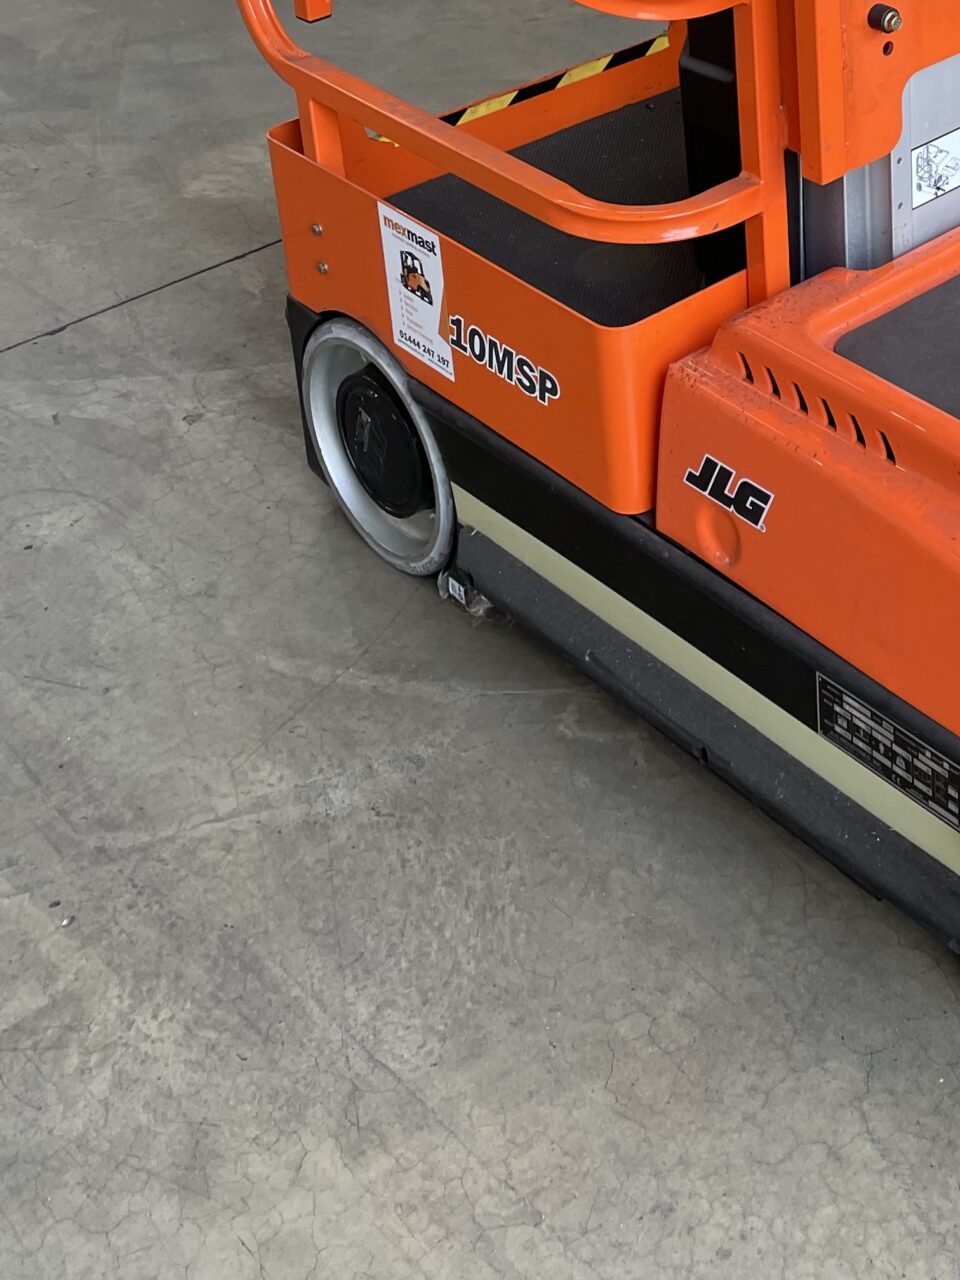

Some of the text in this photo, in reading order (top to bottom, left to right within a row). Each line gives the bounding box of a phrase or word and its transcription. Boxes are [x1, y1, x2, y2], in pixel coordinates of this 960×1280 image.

[383, 215, 437, 257] mexmast
[399, 329, 421, 350] 01444
[422, 344, 435, 359] 247
[437, 354, 450, 369] 197
[449, 315, 560, 407] 10MSP
[683, 453, 774, 531] JLG
